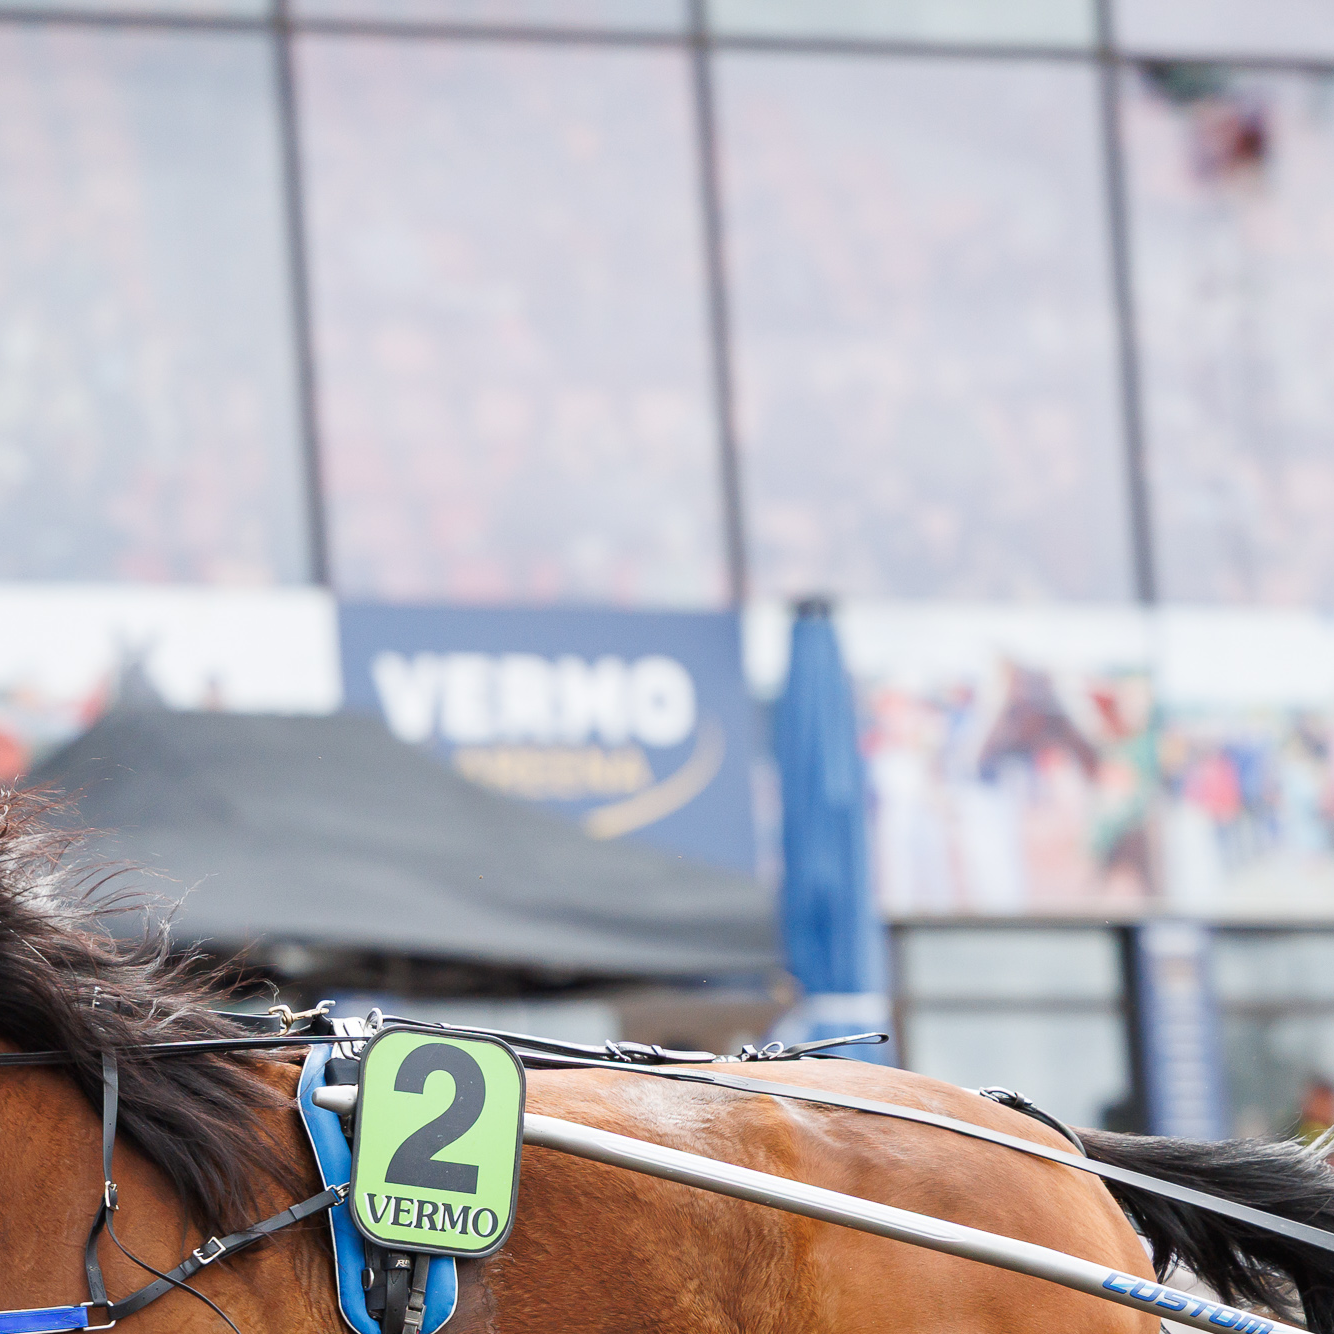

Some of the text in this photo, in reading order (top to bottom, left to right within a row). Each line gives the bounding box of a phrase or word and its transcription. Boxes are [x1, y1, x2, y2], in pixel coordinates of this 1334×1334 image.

[373, 652, 697, 748] VERMO
[384, 1043, 486, 1194] 2
[363, 1192, 499, 1238] VERMO
